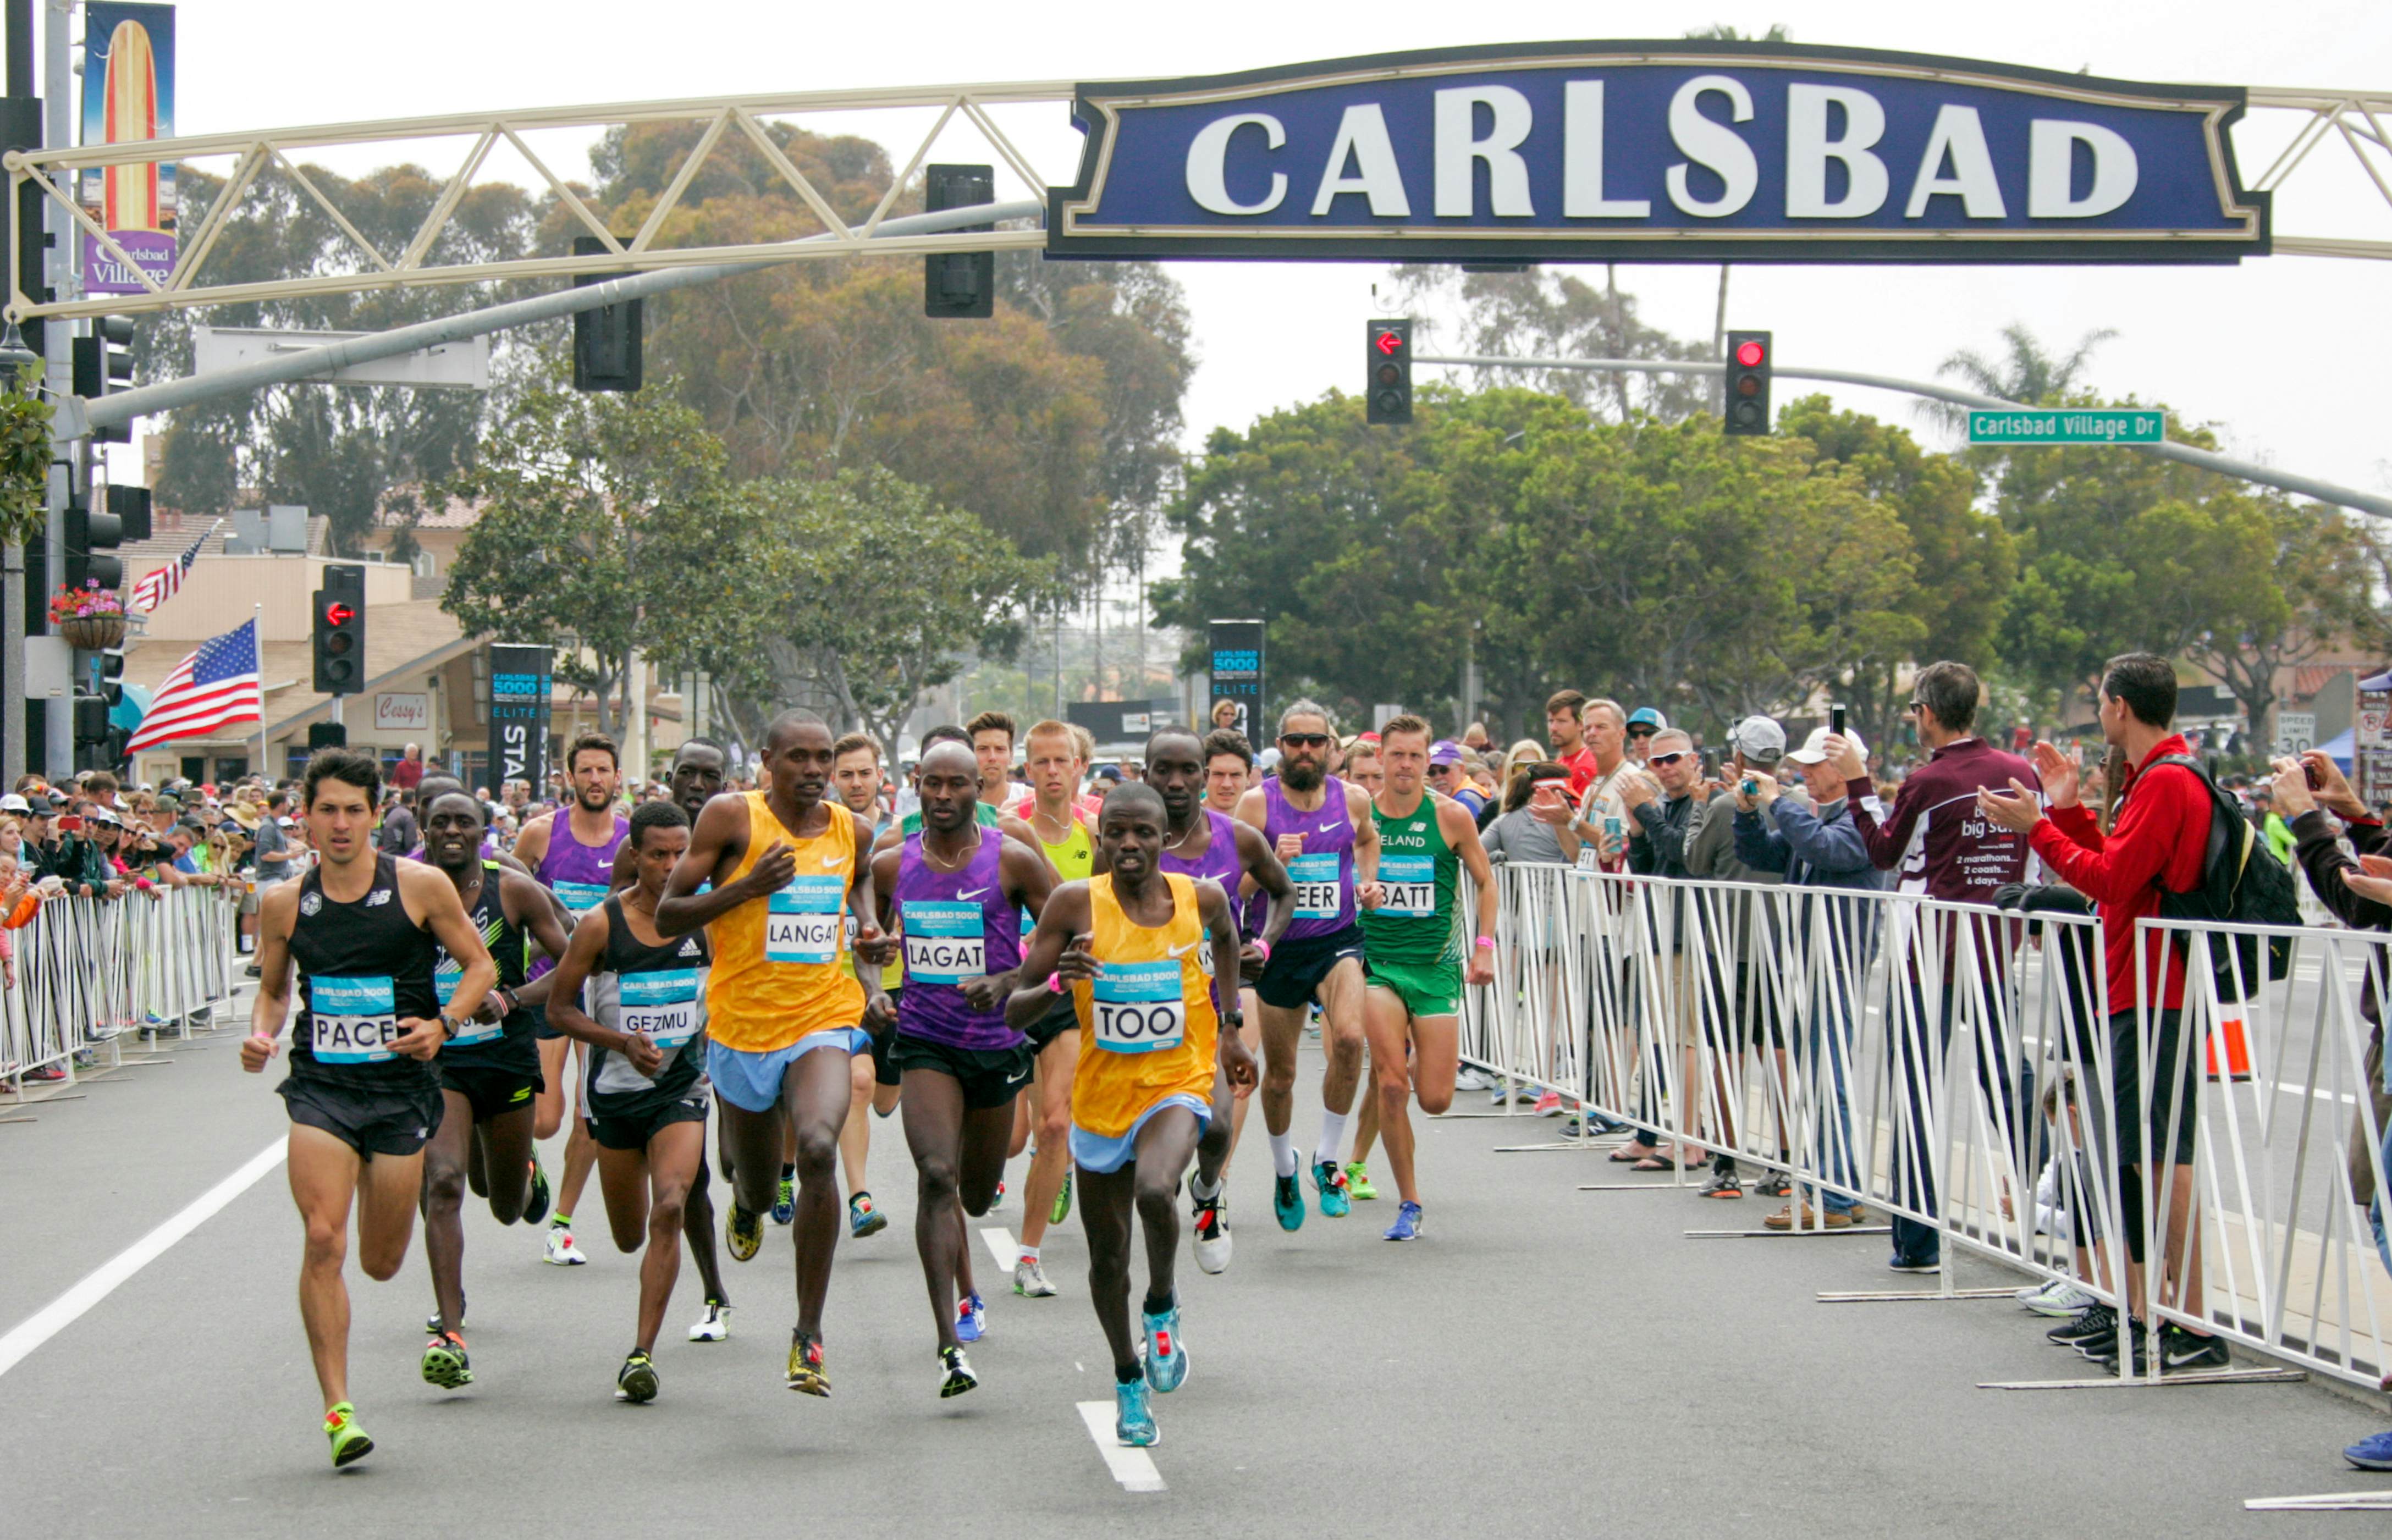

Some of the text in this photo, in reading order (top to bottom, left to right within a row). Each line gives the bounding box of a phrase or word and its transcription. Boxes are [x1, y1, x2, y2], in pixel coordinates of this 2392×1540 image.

[1185, 74, 2139, 218] CARLSBAD
[1975, 415, 2156, 440] Carlsbad Village Dr
[1214, 658, 1259, 671] 5000
[493, 681, 538, 695] 5000
[1213, 685, 1258, 695] ELITE
[493, 706, 537, 718] ELITE
[2280, 716, 2314, 725] SPEED
[2280, 737, 2311, 755] 30
[1961, 819, 1986, 838] big
[1380, 835, 1426, 847] ELAND
[1956, 855, 1963, 864] 2
[1964, 865, 1970, 874] 2
[1297, 886, 1335, 907] EER
[904, 911, 980, 920] CARLSBAD 5000
[770, 924, 837, 943] LANGAT
[678, 949, 702, 957] adidas
[910, 943, 982, 968] LAGAT
[1153, 971, 1179, 982] 5000
[622, 978, 696, 990] CARLSBAD 5000
[626, 1012, 687, 1033] GEZMU
[1100, 1006, 1176, 1039] TOO
[317, 1019, 394, 1047] PACE
